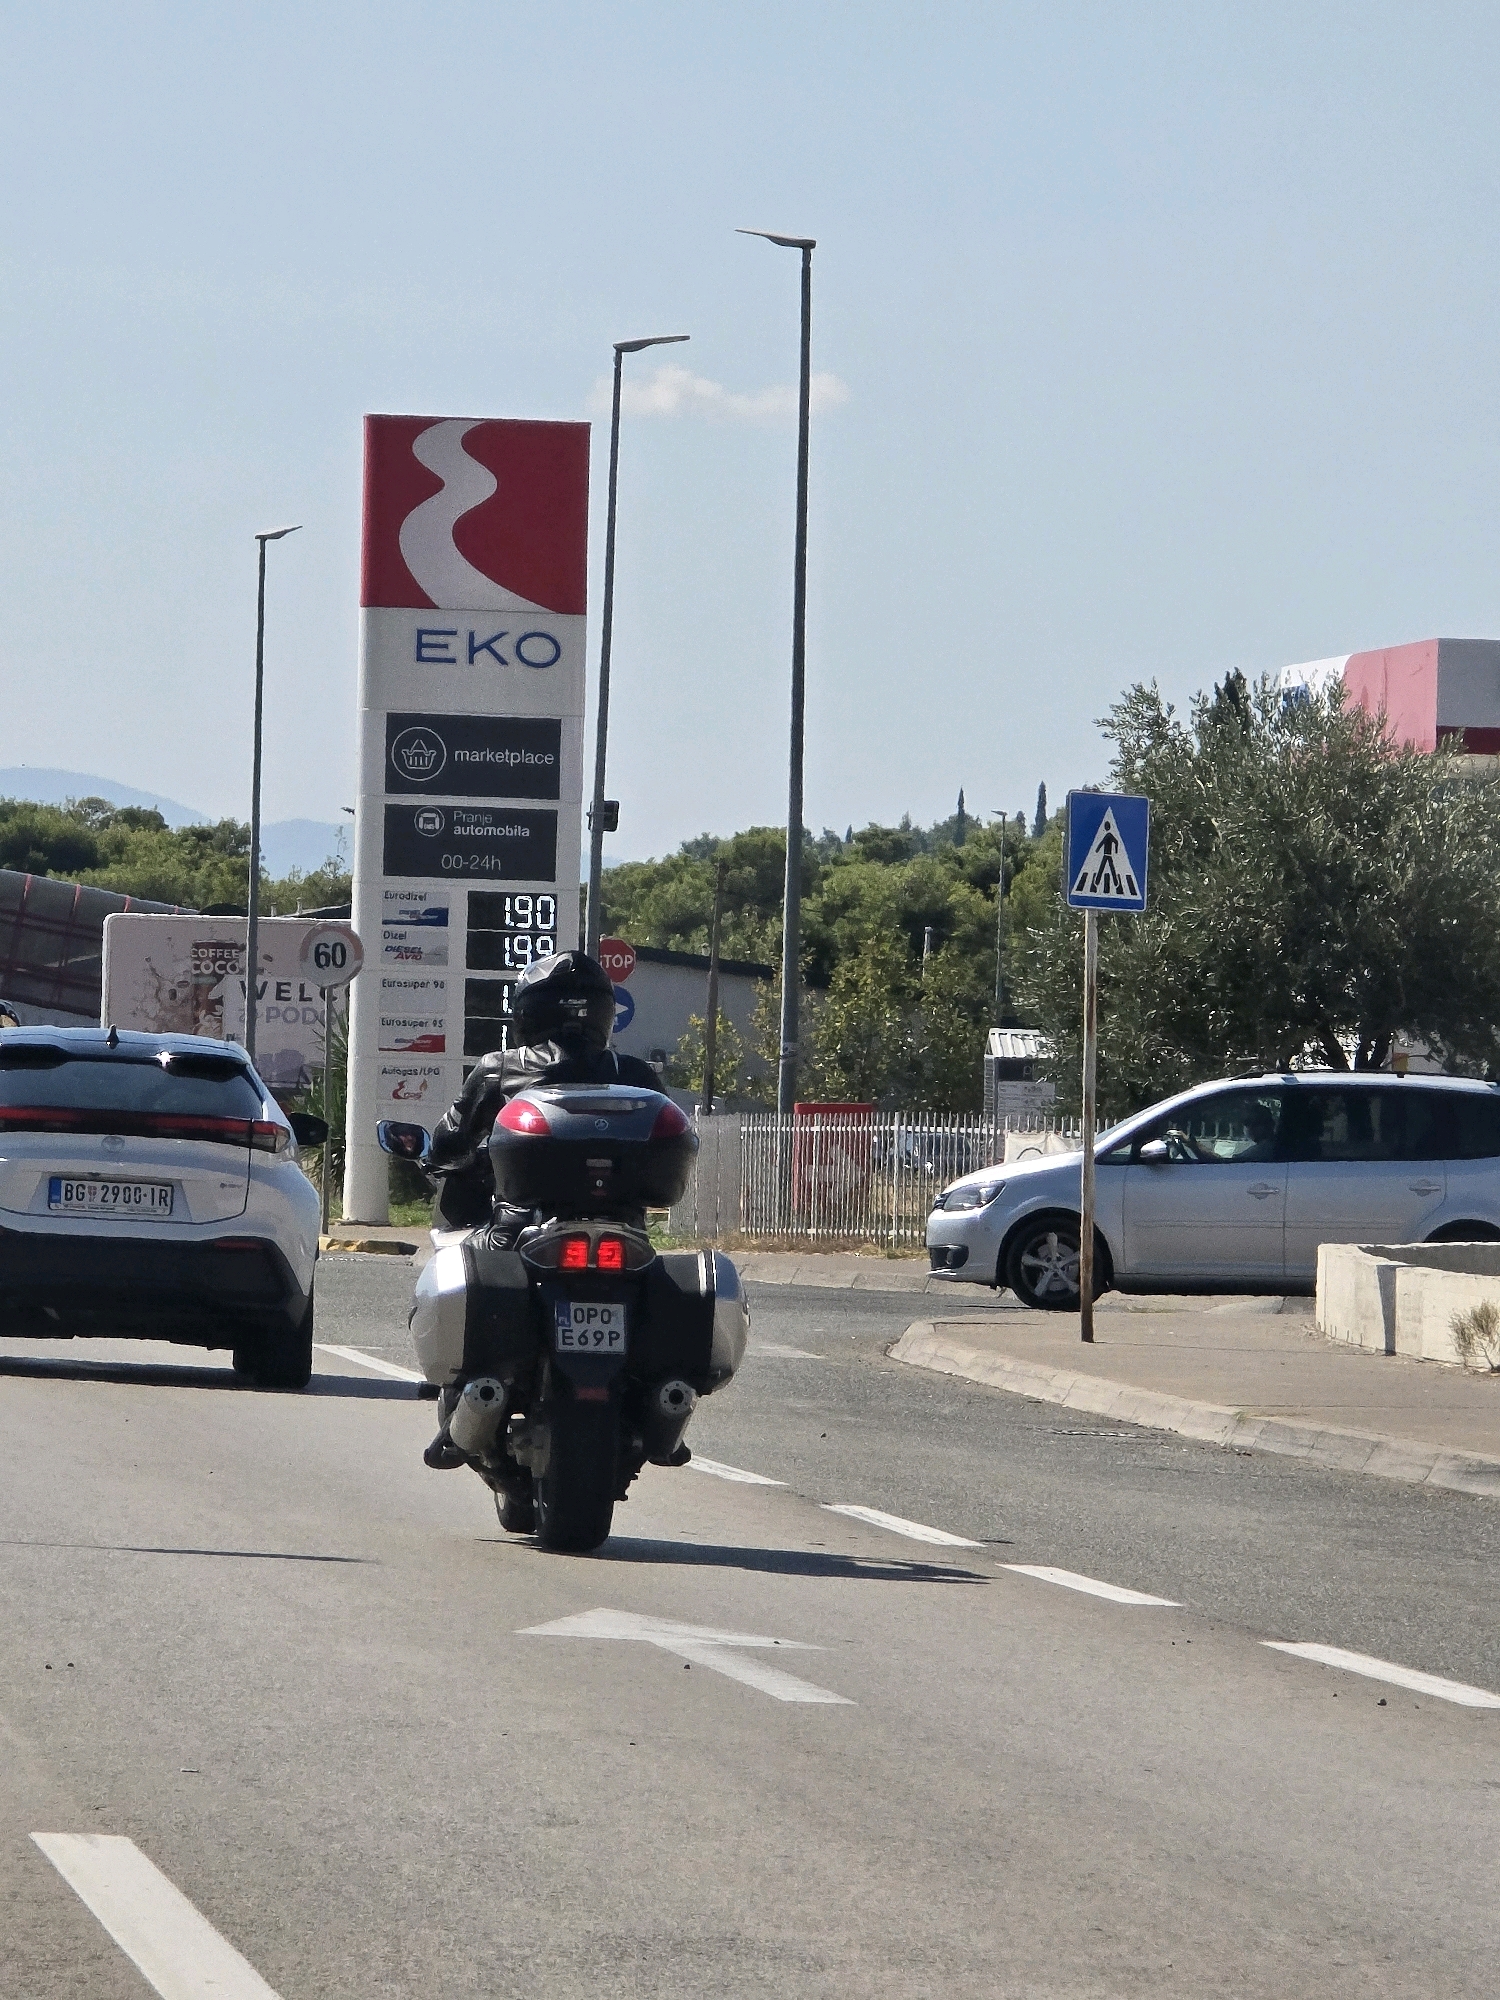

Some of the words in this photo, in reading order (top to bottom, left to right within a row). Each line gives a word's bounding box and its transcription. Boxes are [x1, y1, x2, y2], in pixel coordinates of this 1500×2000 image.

[416, 629, 561, 669] EKO
[454, 748, 555, 767] marketplace
[453, 810, 493, 826] Pranje
[453, 825, 530, 837] automobila
[441, 854, 501, 870] 00-24h
[384, 890, 428, 901] Eurodizel
[383, 930, 407, 940] Dizel
[191, 948, 240, 959] COFFEE
[314, 942, 347, 968] 60
[382, 979, 430, 989] Eurosuper
[381, 1018, 429, 1028] Eurosuper
[432, 1019, 444, 1028] 95
[64, 1182, 86, 1202] BG
[561, 1328, 621, 1347] E69P
